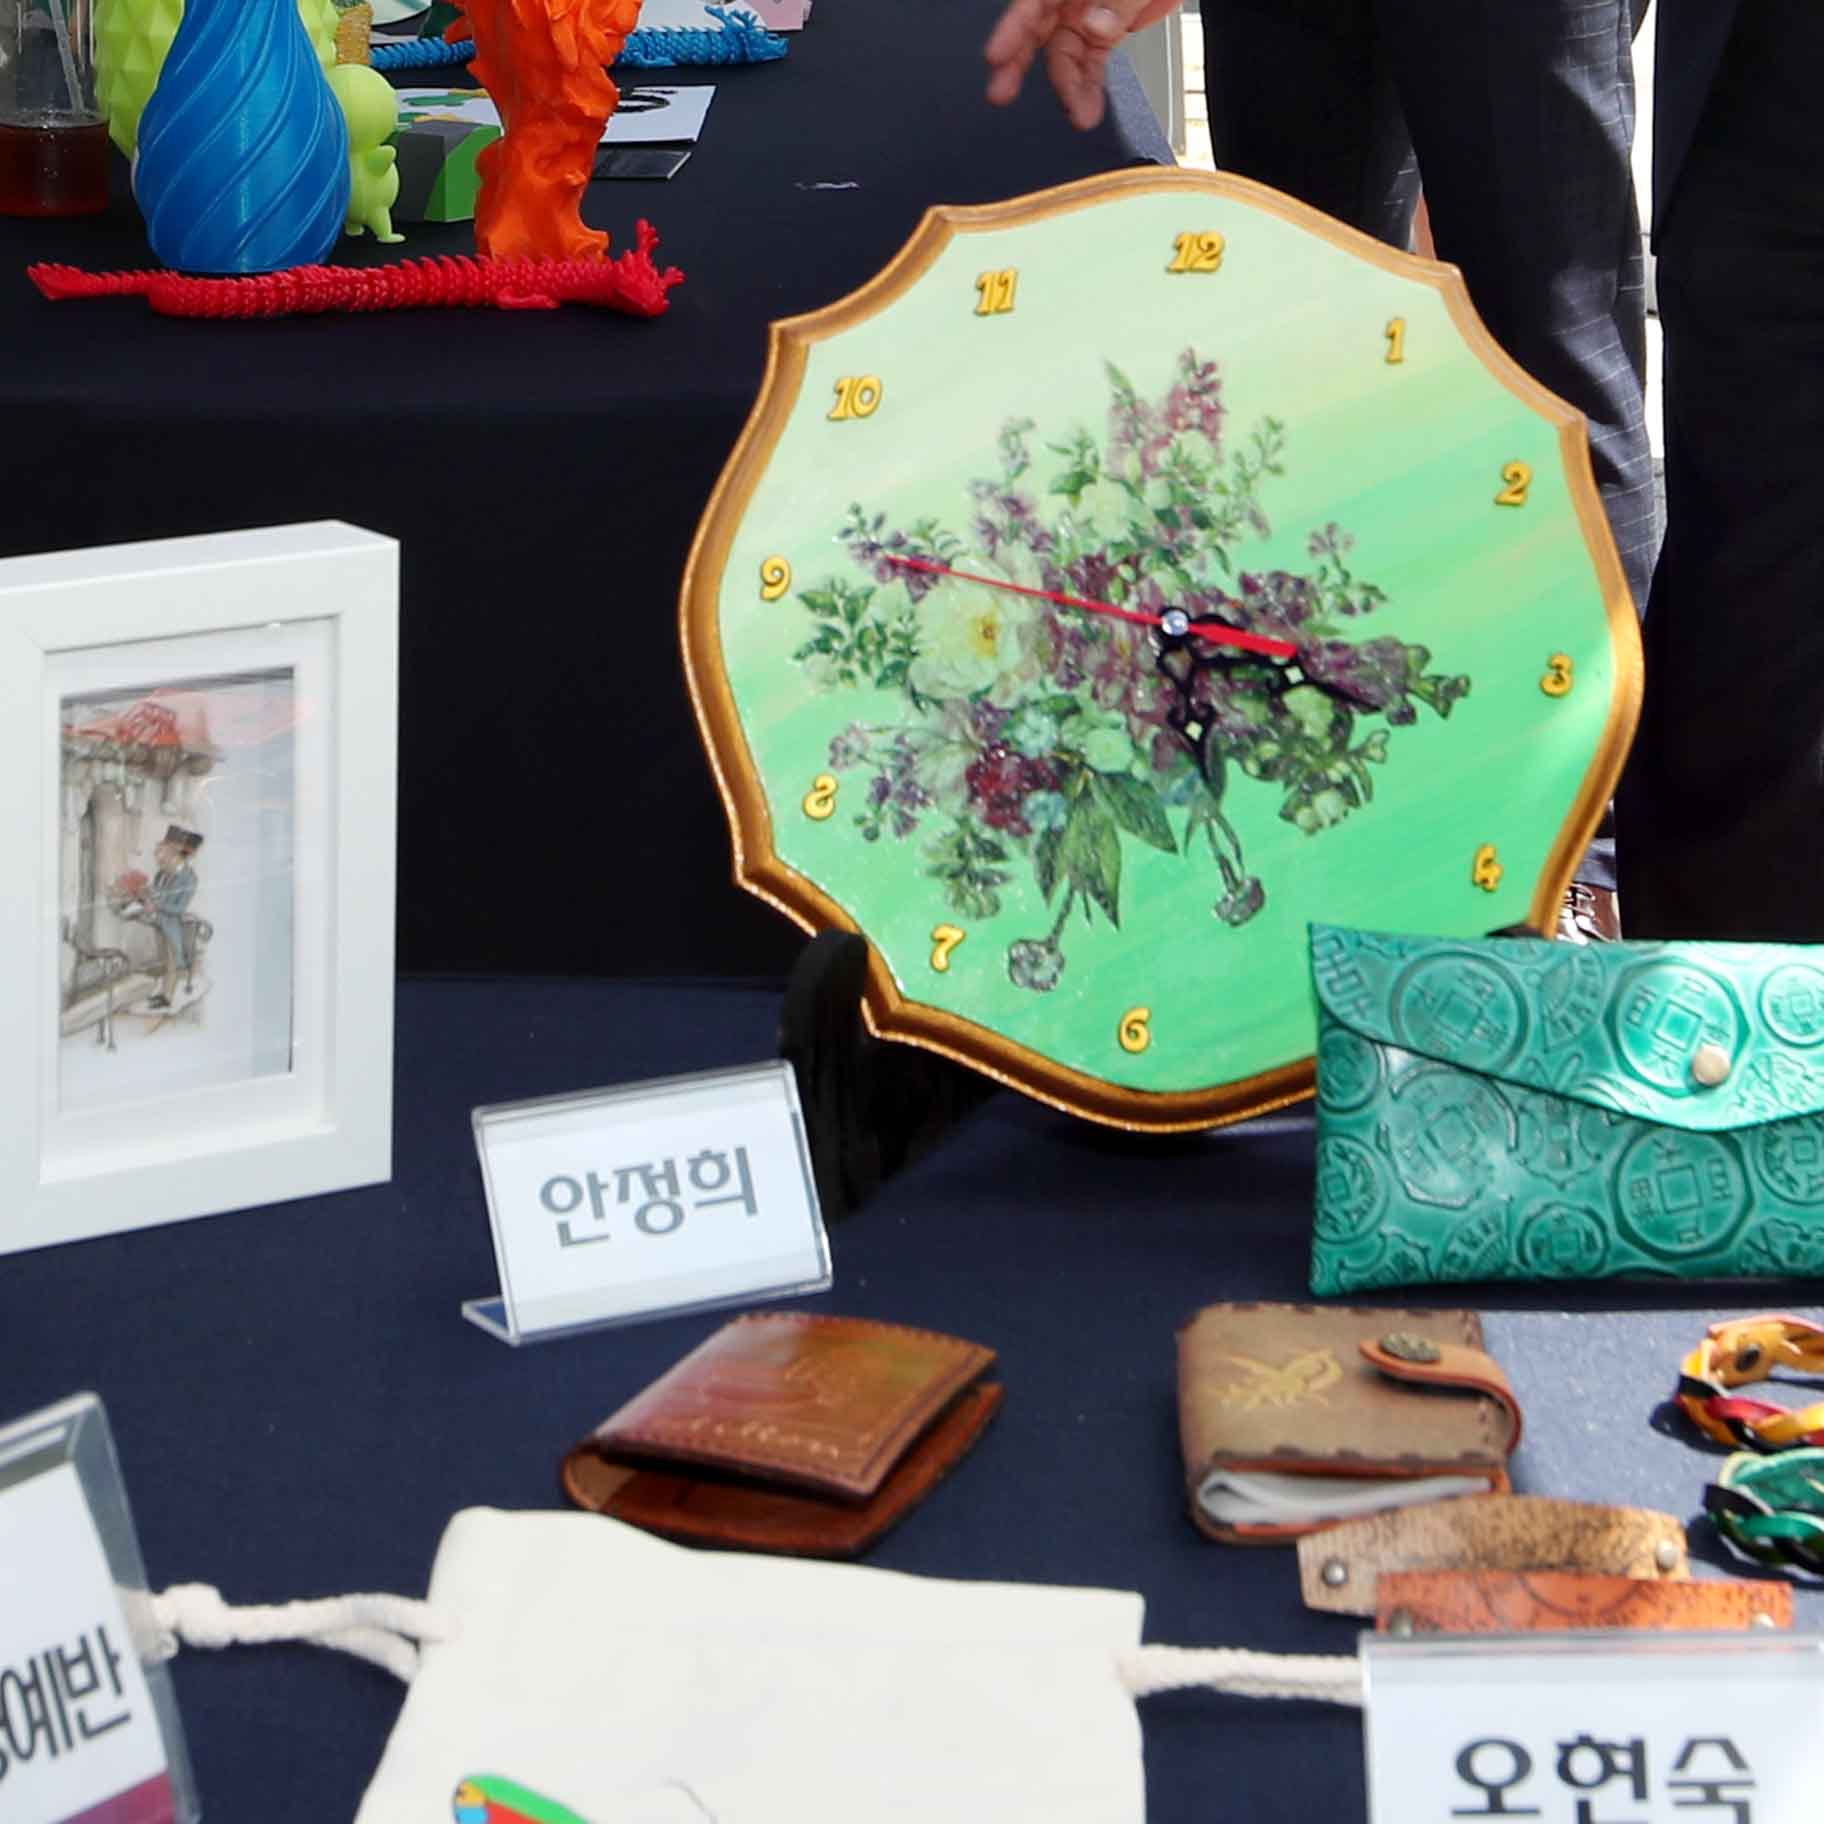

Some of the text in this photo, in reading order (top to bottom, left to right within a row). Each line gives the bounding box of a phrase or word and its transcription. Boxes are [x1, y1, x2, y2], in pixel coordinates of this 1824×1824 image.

[1166, 229, 1225, 275] 12
[974, 268, 1021, 315] 11
[1385, 317, 1409, 364] 1
[827, 374, 884, 422] 10
[1495, 459, 1532, 508] 2
[758, 554, 793, 602] 9
[1540, 655, 1575, 698] 3
[802, 775, 839, 822] 8
[1470, 845, 1505, 893] 4
[930, 923, 965, 972] 7
[1117, 1006, 1152, 1055] 6
[538, 1144, 758, 1249] 안정희
[1449, 1732, 1758, 1824] 오현숙
